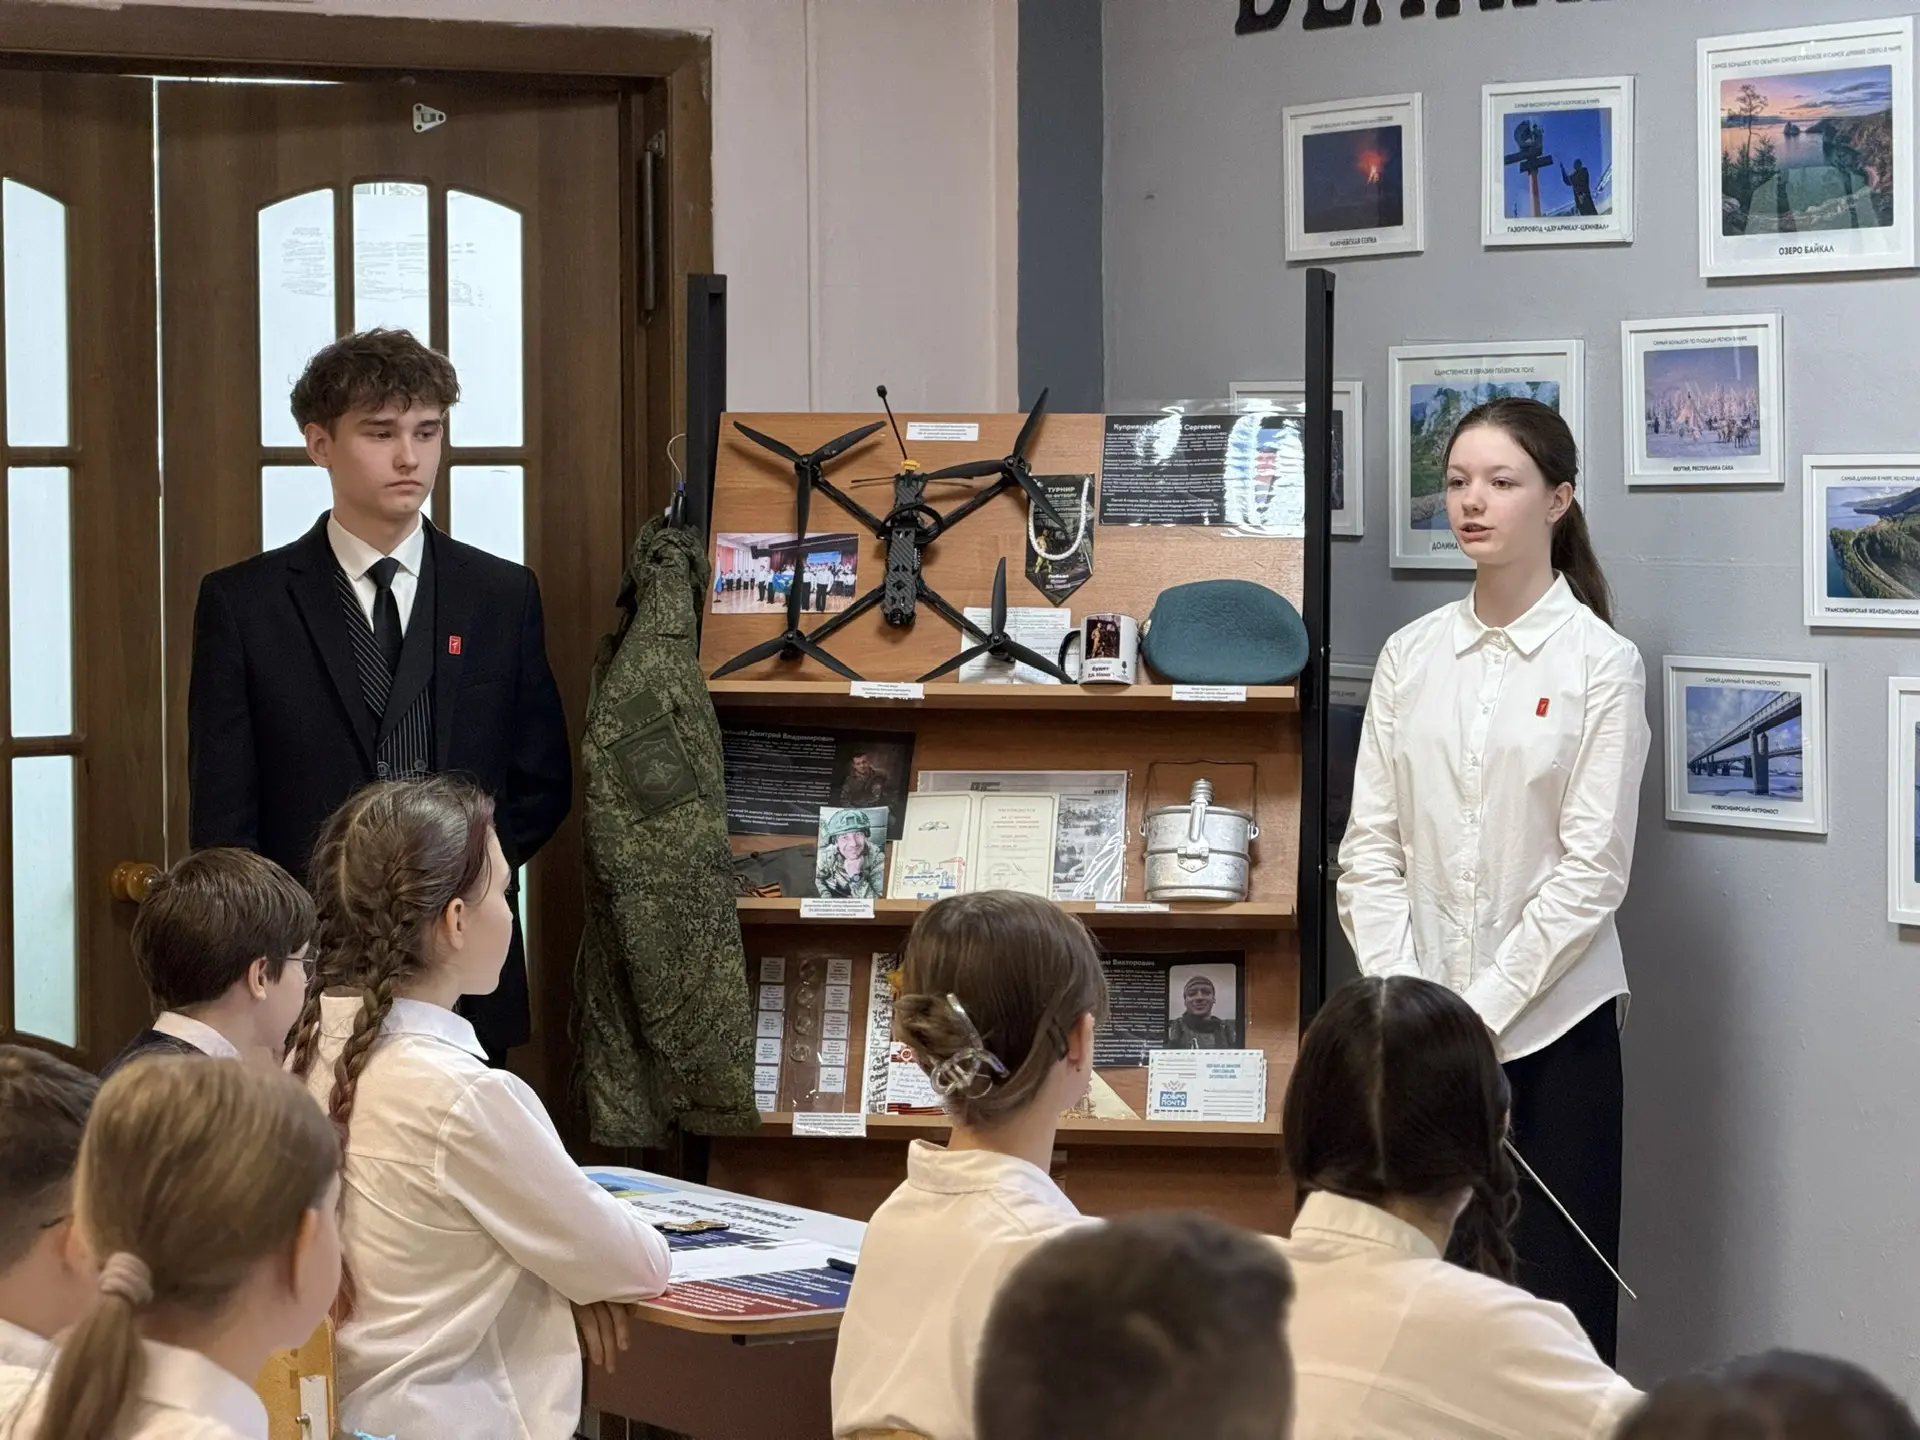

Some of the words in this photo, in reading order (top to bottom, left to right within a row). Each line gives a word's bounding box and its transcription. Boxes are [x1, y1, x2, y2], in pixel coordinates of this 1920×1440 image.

[1507, 225, 1543, 233] ГАЗОПРОВОД
[1778, 246, 1803, 256] ОЗЕРО
[1804, 243, 1835, 254] БАЙКАЛ
[1183, 423, 1220, 433] Сергеевич
[1432, 541, 1458, 551] ДОЛИНА
[748, 729, 782, 739] Дмитрий
[782, 731, 836, 742] Владимирович
[1112, 957, 1156, 967] Викторович
[1160, 1099, 1186, 1107] ПОЧТА
